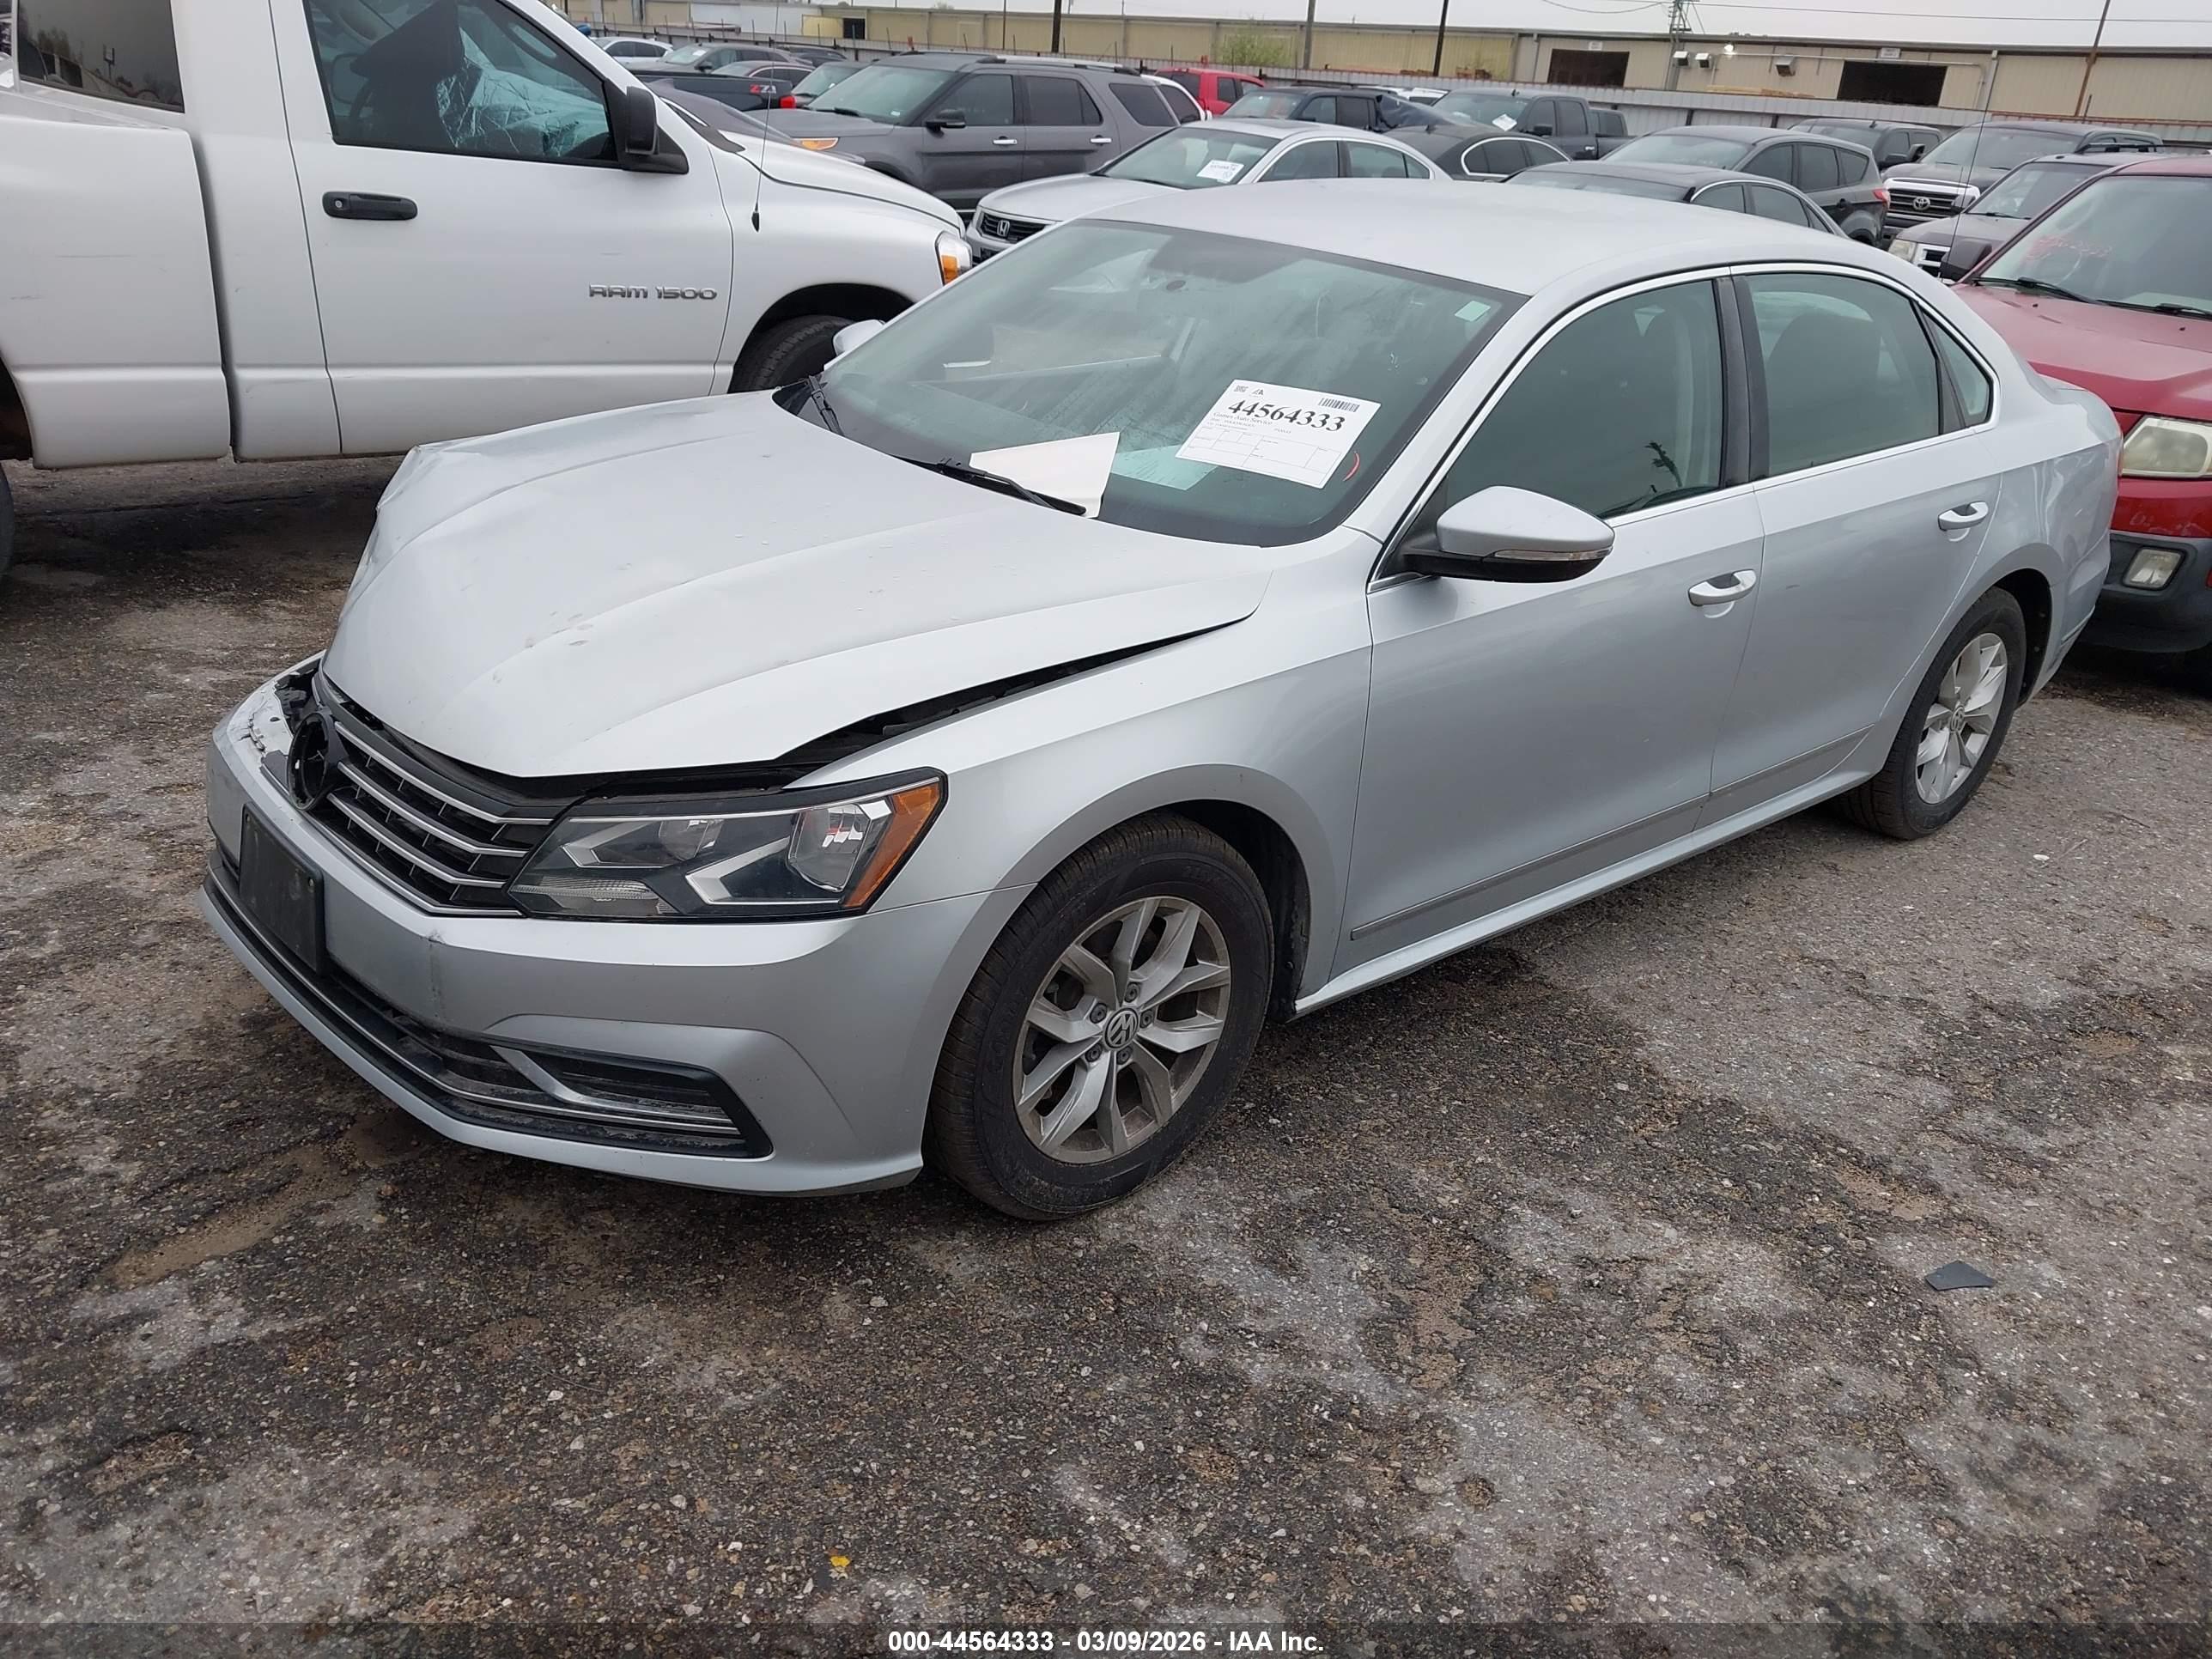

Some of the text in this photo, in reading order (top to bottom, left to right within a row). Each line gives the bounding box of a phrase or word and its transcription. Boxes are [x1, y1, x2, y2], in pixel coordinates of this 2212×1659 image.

[750, 84, 776, 94] Z71
[588, 284, 718, 300] RAM 1500
[1228, 399, 1346, 432] 44564333
